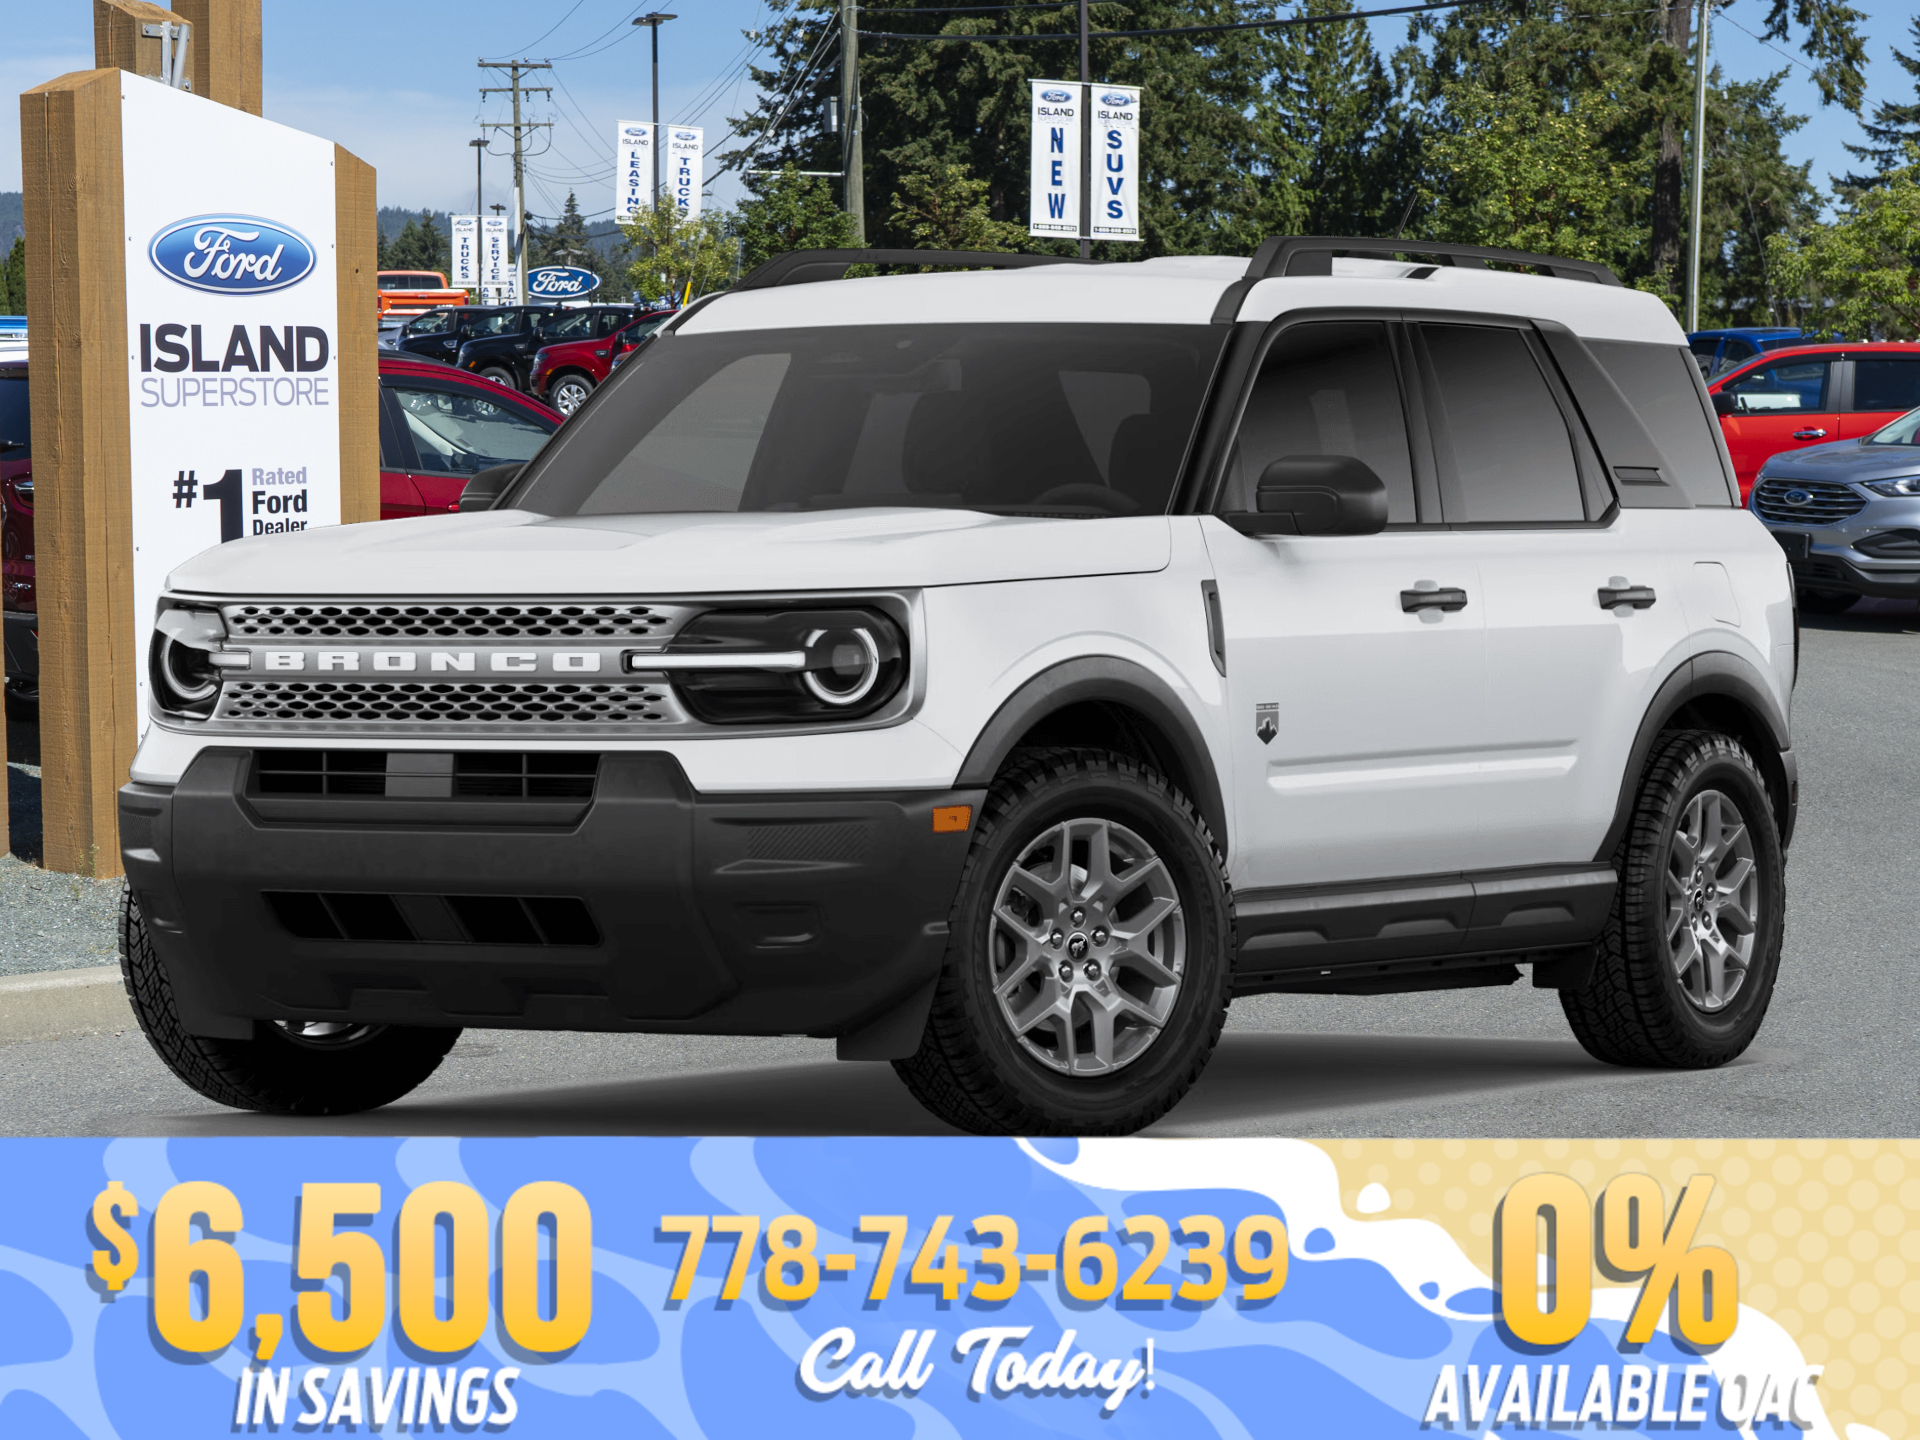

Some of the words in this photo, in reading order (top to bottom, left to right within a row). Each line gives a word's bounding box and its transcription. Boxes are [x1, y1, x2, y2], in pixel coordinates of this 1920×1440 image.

[1038, 107, 1074, 116] ISLAND
[1098, 111, 1133, 120] ISLAND
[678, 157, 691, 216] TRUCKS
[1048, 127, 1066, 219] NEW
[1107, 130, 1124, 219] SUVS
[184, 226, 285, 282] Ford
[461, 237, 469, 279] TRUCKS
[491, 237, 499, 280] SERVICE
[532, 271, 583, 292] Ford
[140, 323, 330, 373] ISLAND
[140, 376, 330, 408] SUPERSTORE
[172, 468, 244, 545] #1
[252, 466, 307, 486] Rated
[252, 489, 308, 515] Ford
[252, 518, 308, 536] Dealer
[265, 651, 601, 672] BRONCO
